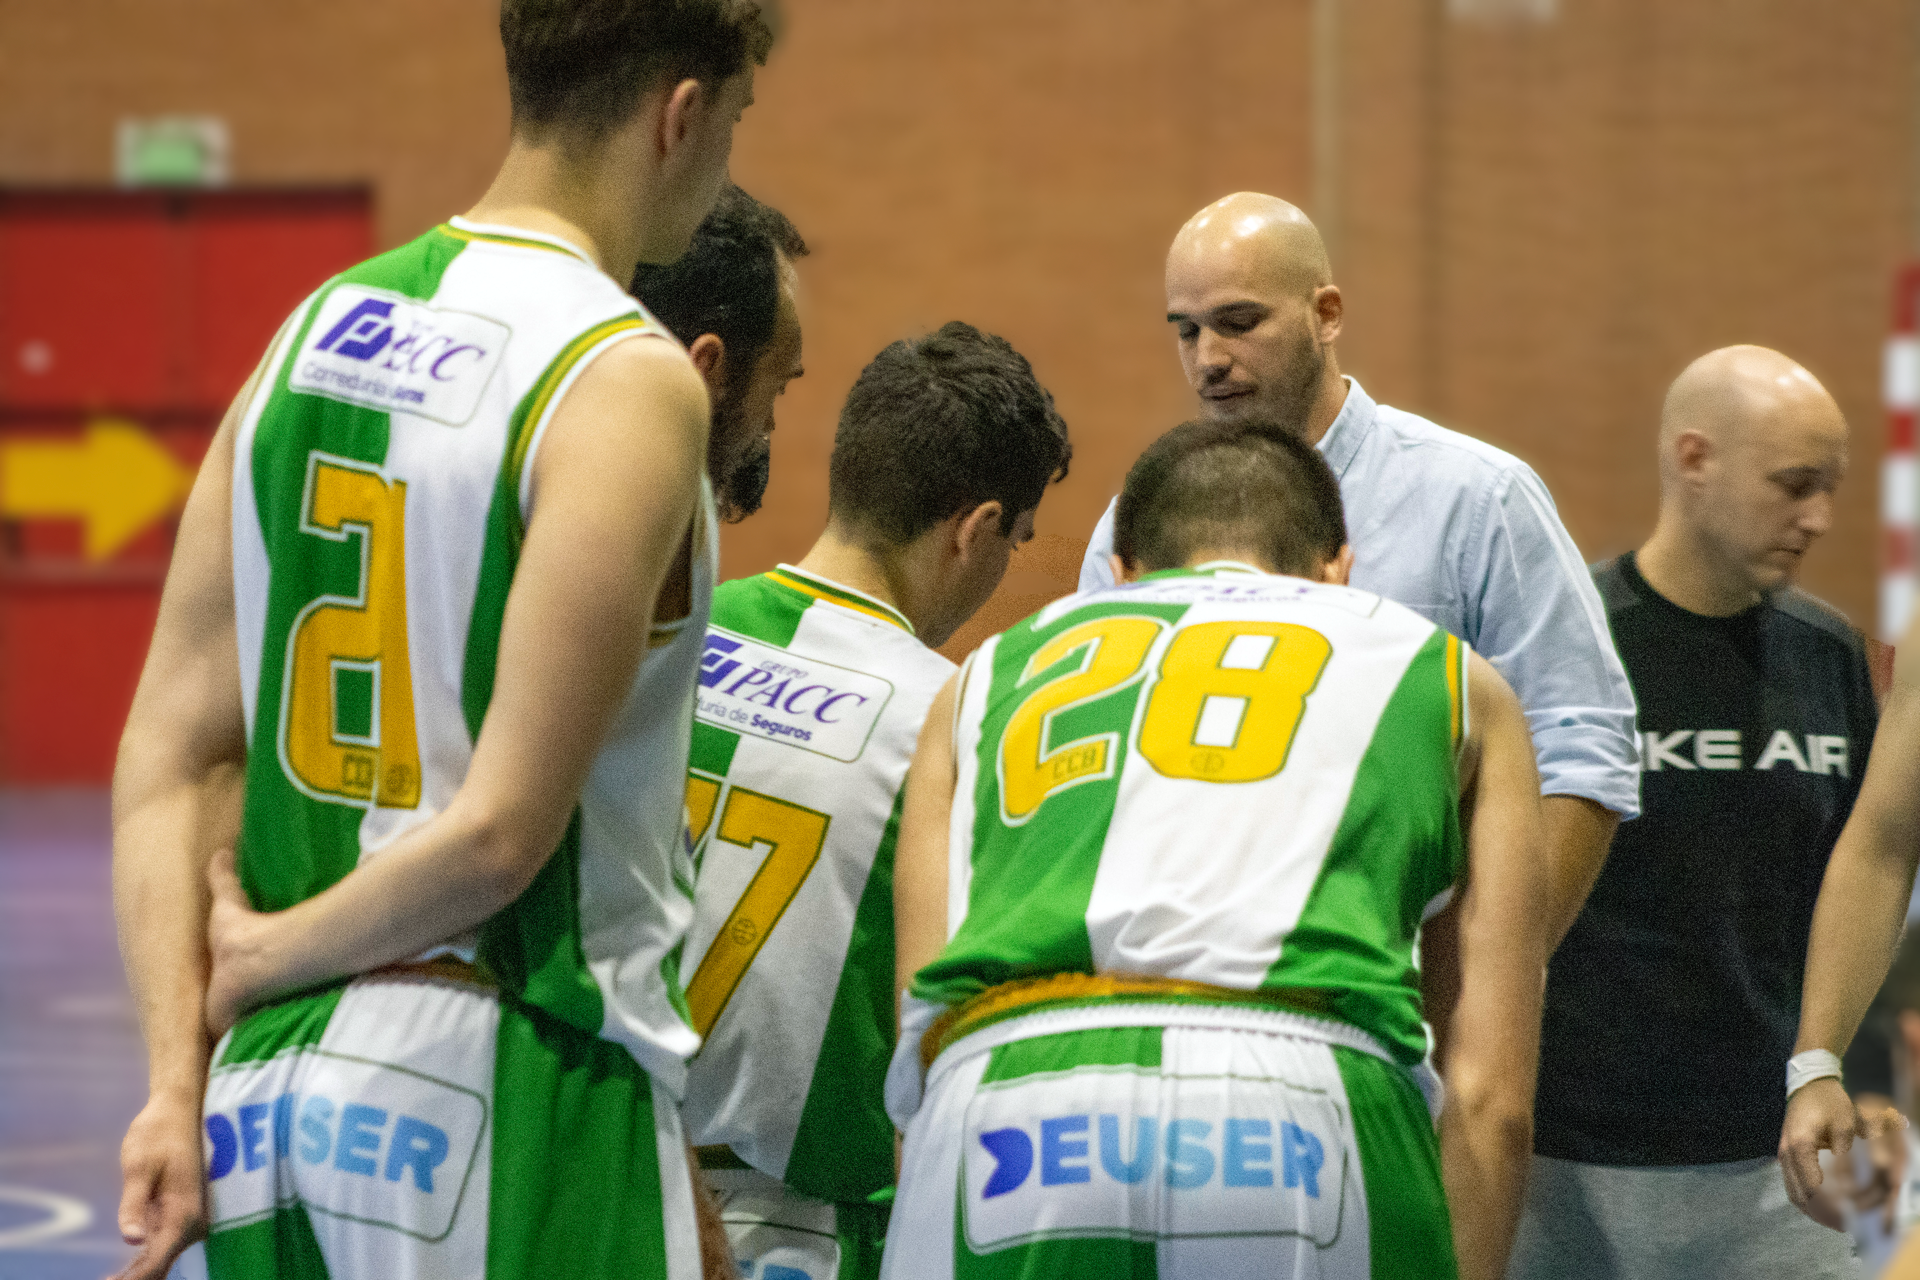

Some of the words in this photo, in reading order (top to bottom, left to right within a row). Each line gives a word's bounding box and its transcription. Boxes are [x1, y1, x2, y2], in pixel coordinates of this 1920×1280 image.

[722, 666, 869, 723] PACC
[997, 615, 1334, 827] 28
[729, 707, 749, 723] de
[750, 714, 812, 741] Seguros
[1640, 730, 1742, 772] KE
[979, 1113, 1325, 1200] DEUSER
